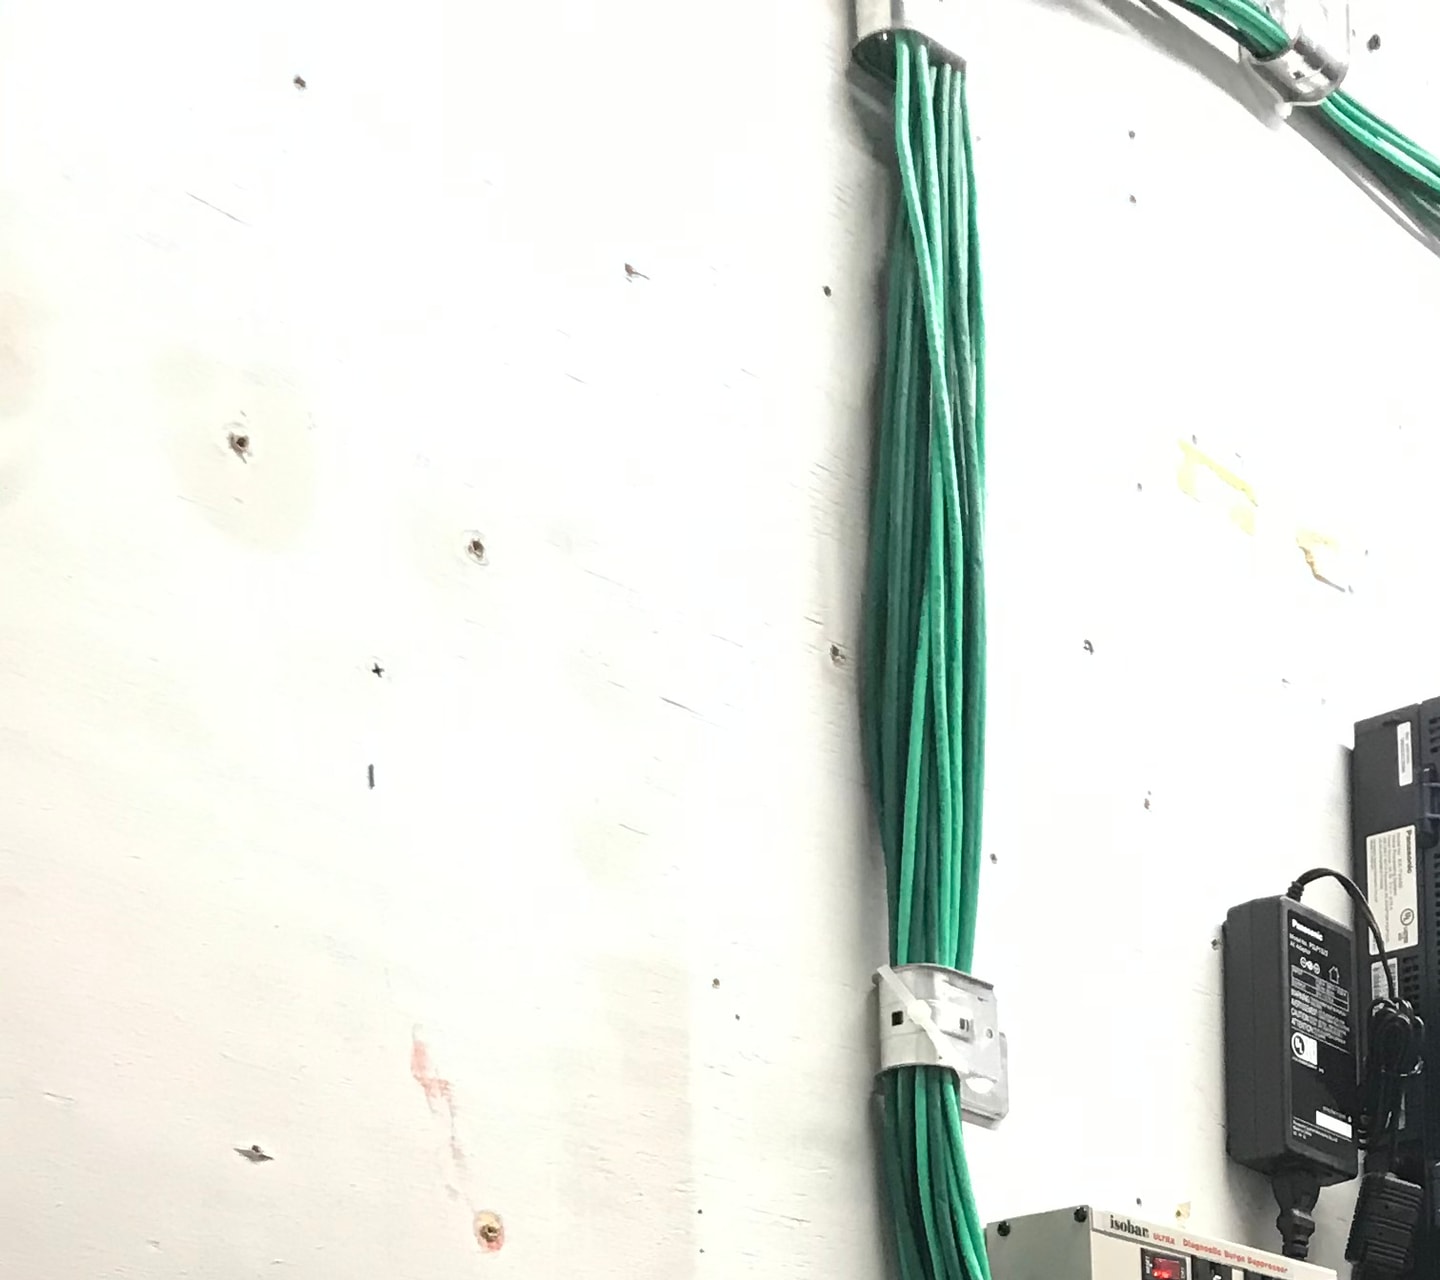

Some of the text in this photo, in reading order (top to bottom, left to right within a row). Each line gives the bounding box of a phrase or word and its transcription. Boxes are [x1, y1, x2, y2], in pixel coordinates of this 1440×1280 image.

[1110, 1215, 1148, 1238] isobar
[1183, 1238, 1222, 1256] Diagnostic
[1224, 1250, 1246, 1263] Surge
[1247, 1257, 1288, 1274] Suppressor
